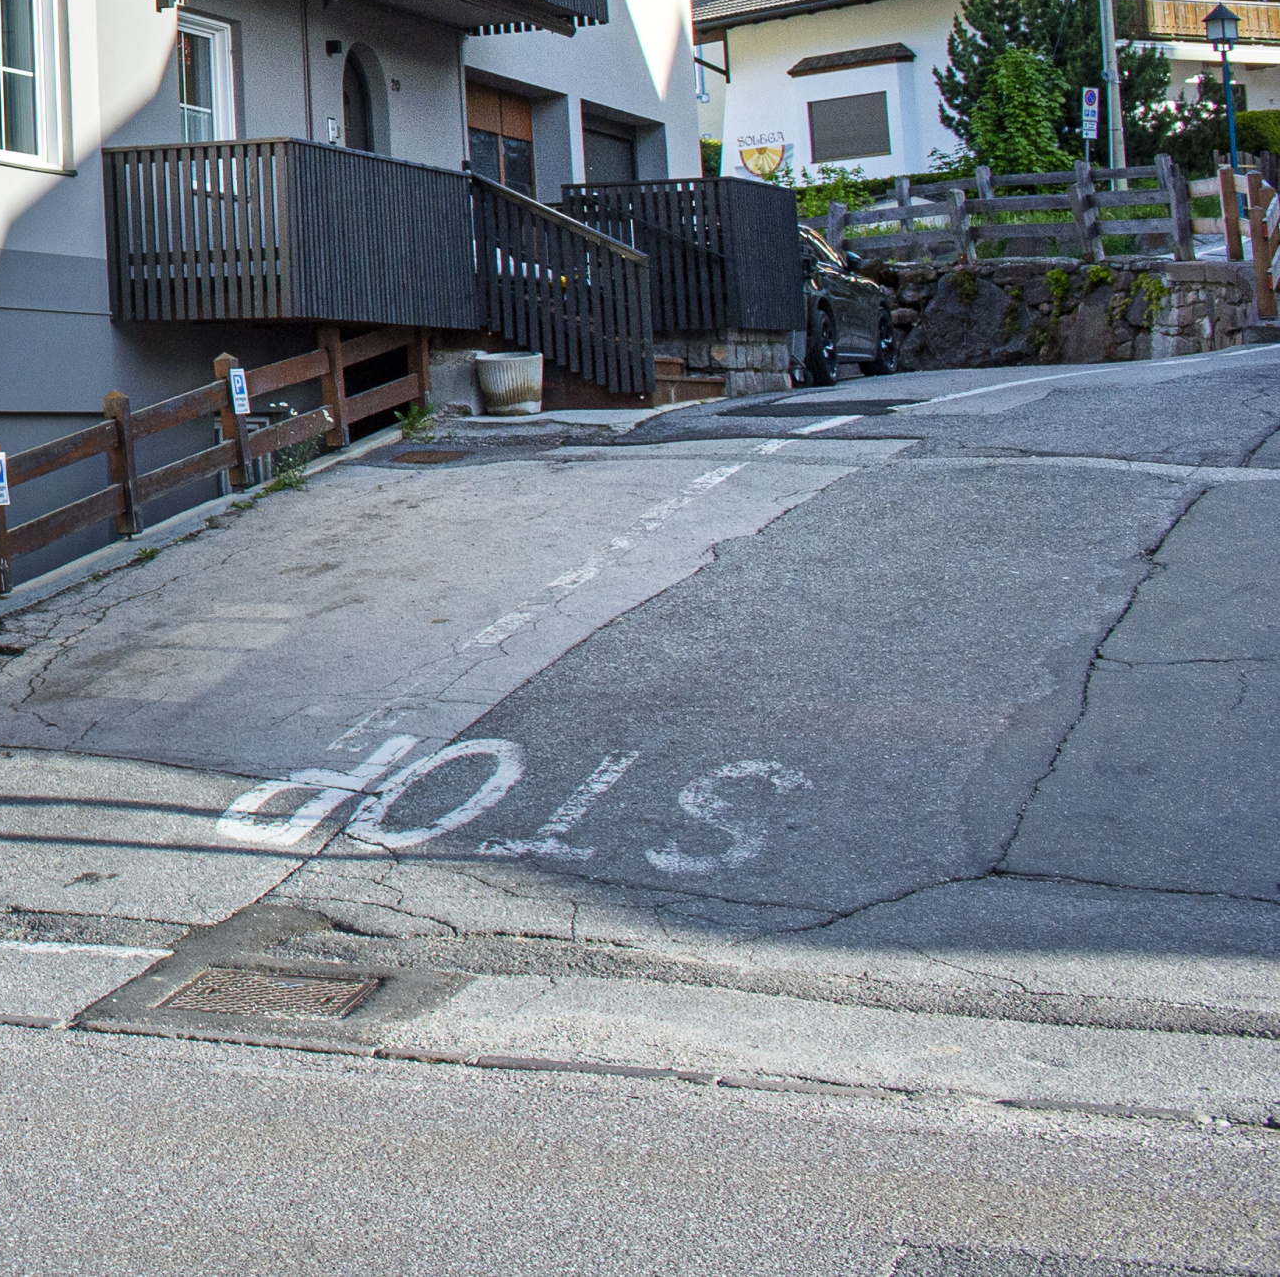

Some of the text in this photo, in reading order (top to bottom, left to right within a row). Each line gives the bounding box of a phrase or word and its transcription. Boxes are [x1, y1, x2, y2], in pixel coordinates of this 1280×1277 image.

[391, 78, 401, 93] 20
[737, 131, 785, 147] SOLEGA
[217, 734, 814, 874] STOP
